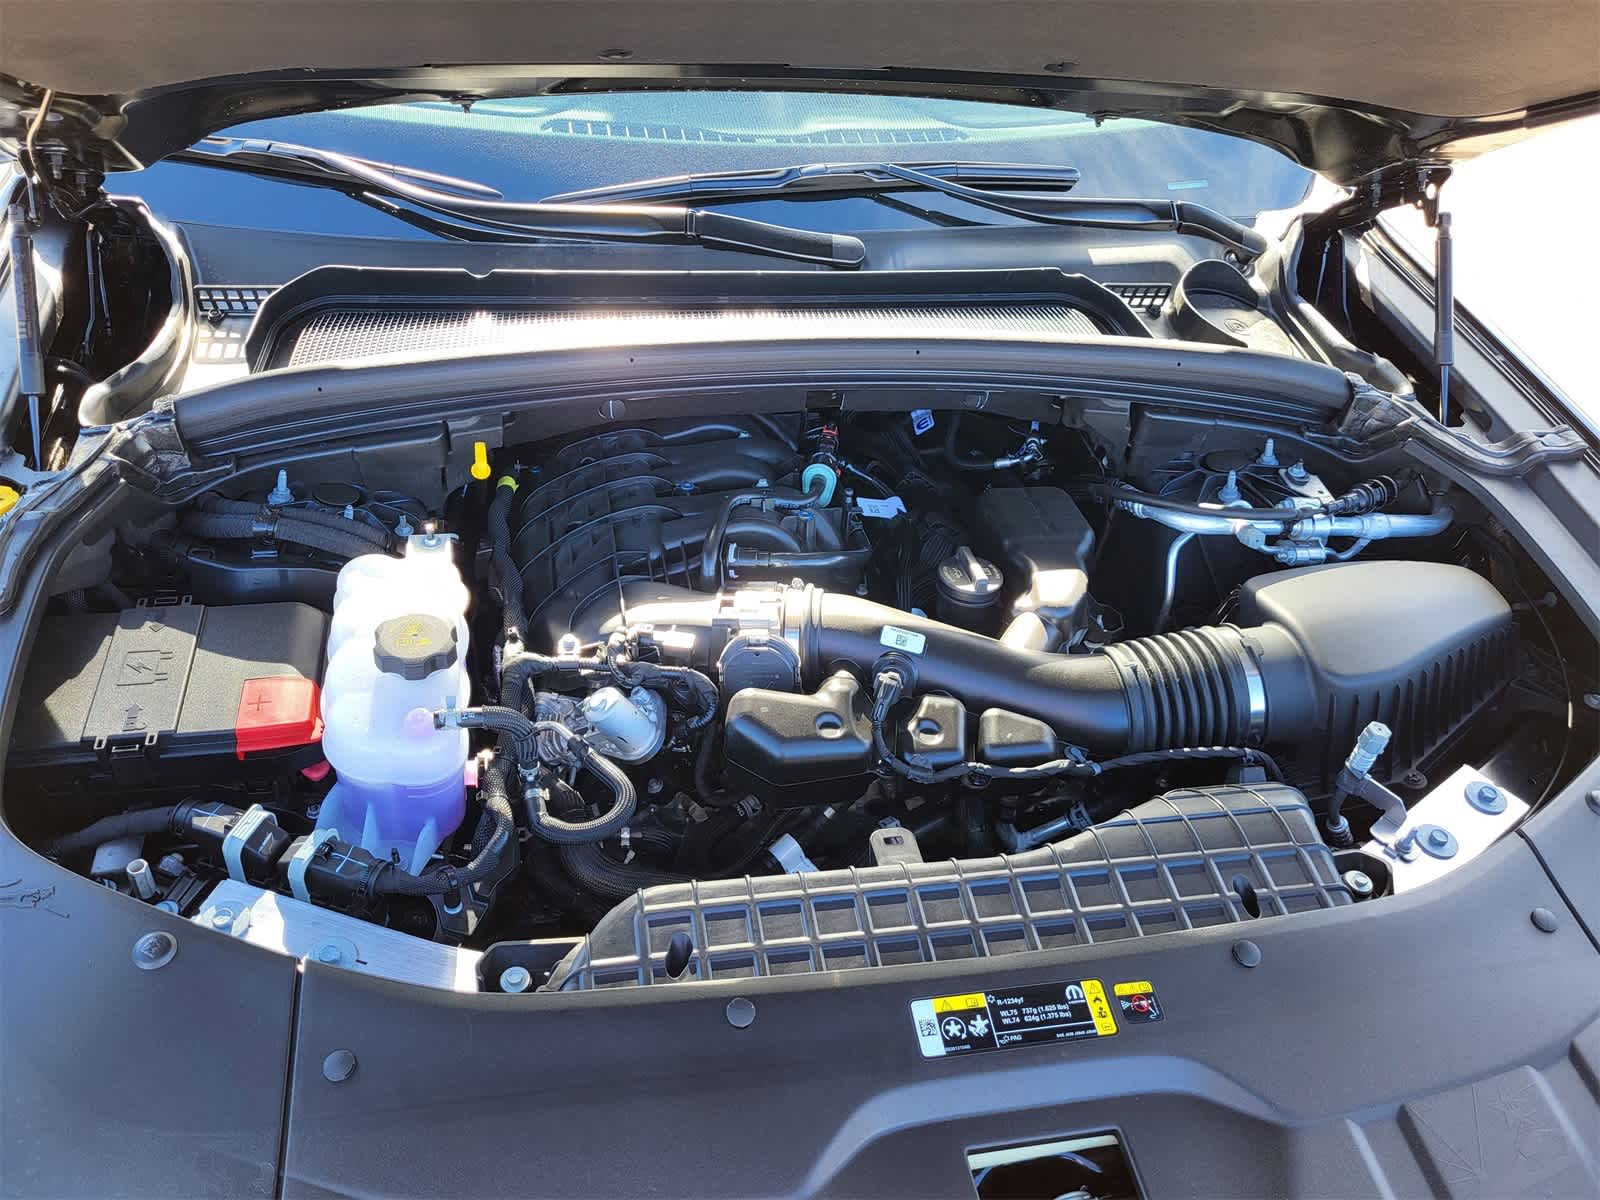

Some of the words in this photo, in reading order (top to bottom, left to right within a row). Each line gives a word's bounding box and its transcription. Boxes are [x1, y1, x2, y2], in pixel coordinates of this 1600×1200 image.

[1000, 1009, 1018, 1017] WL75
[1022, 1007, 1038, 1015] 737g
[1002, 1017, 1020, 1025] WL74
